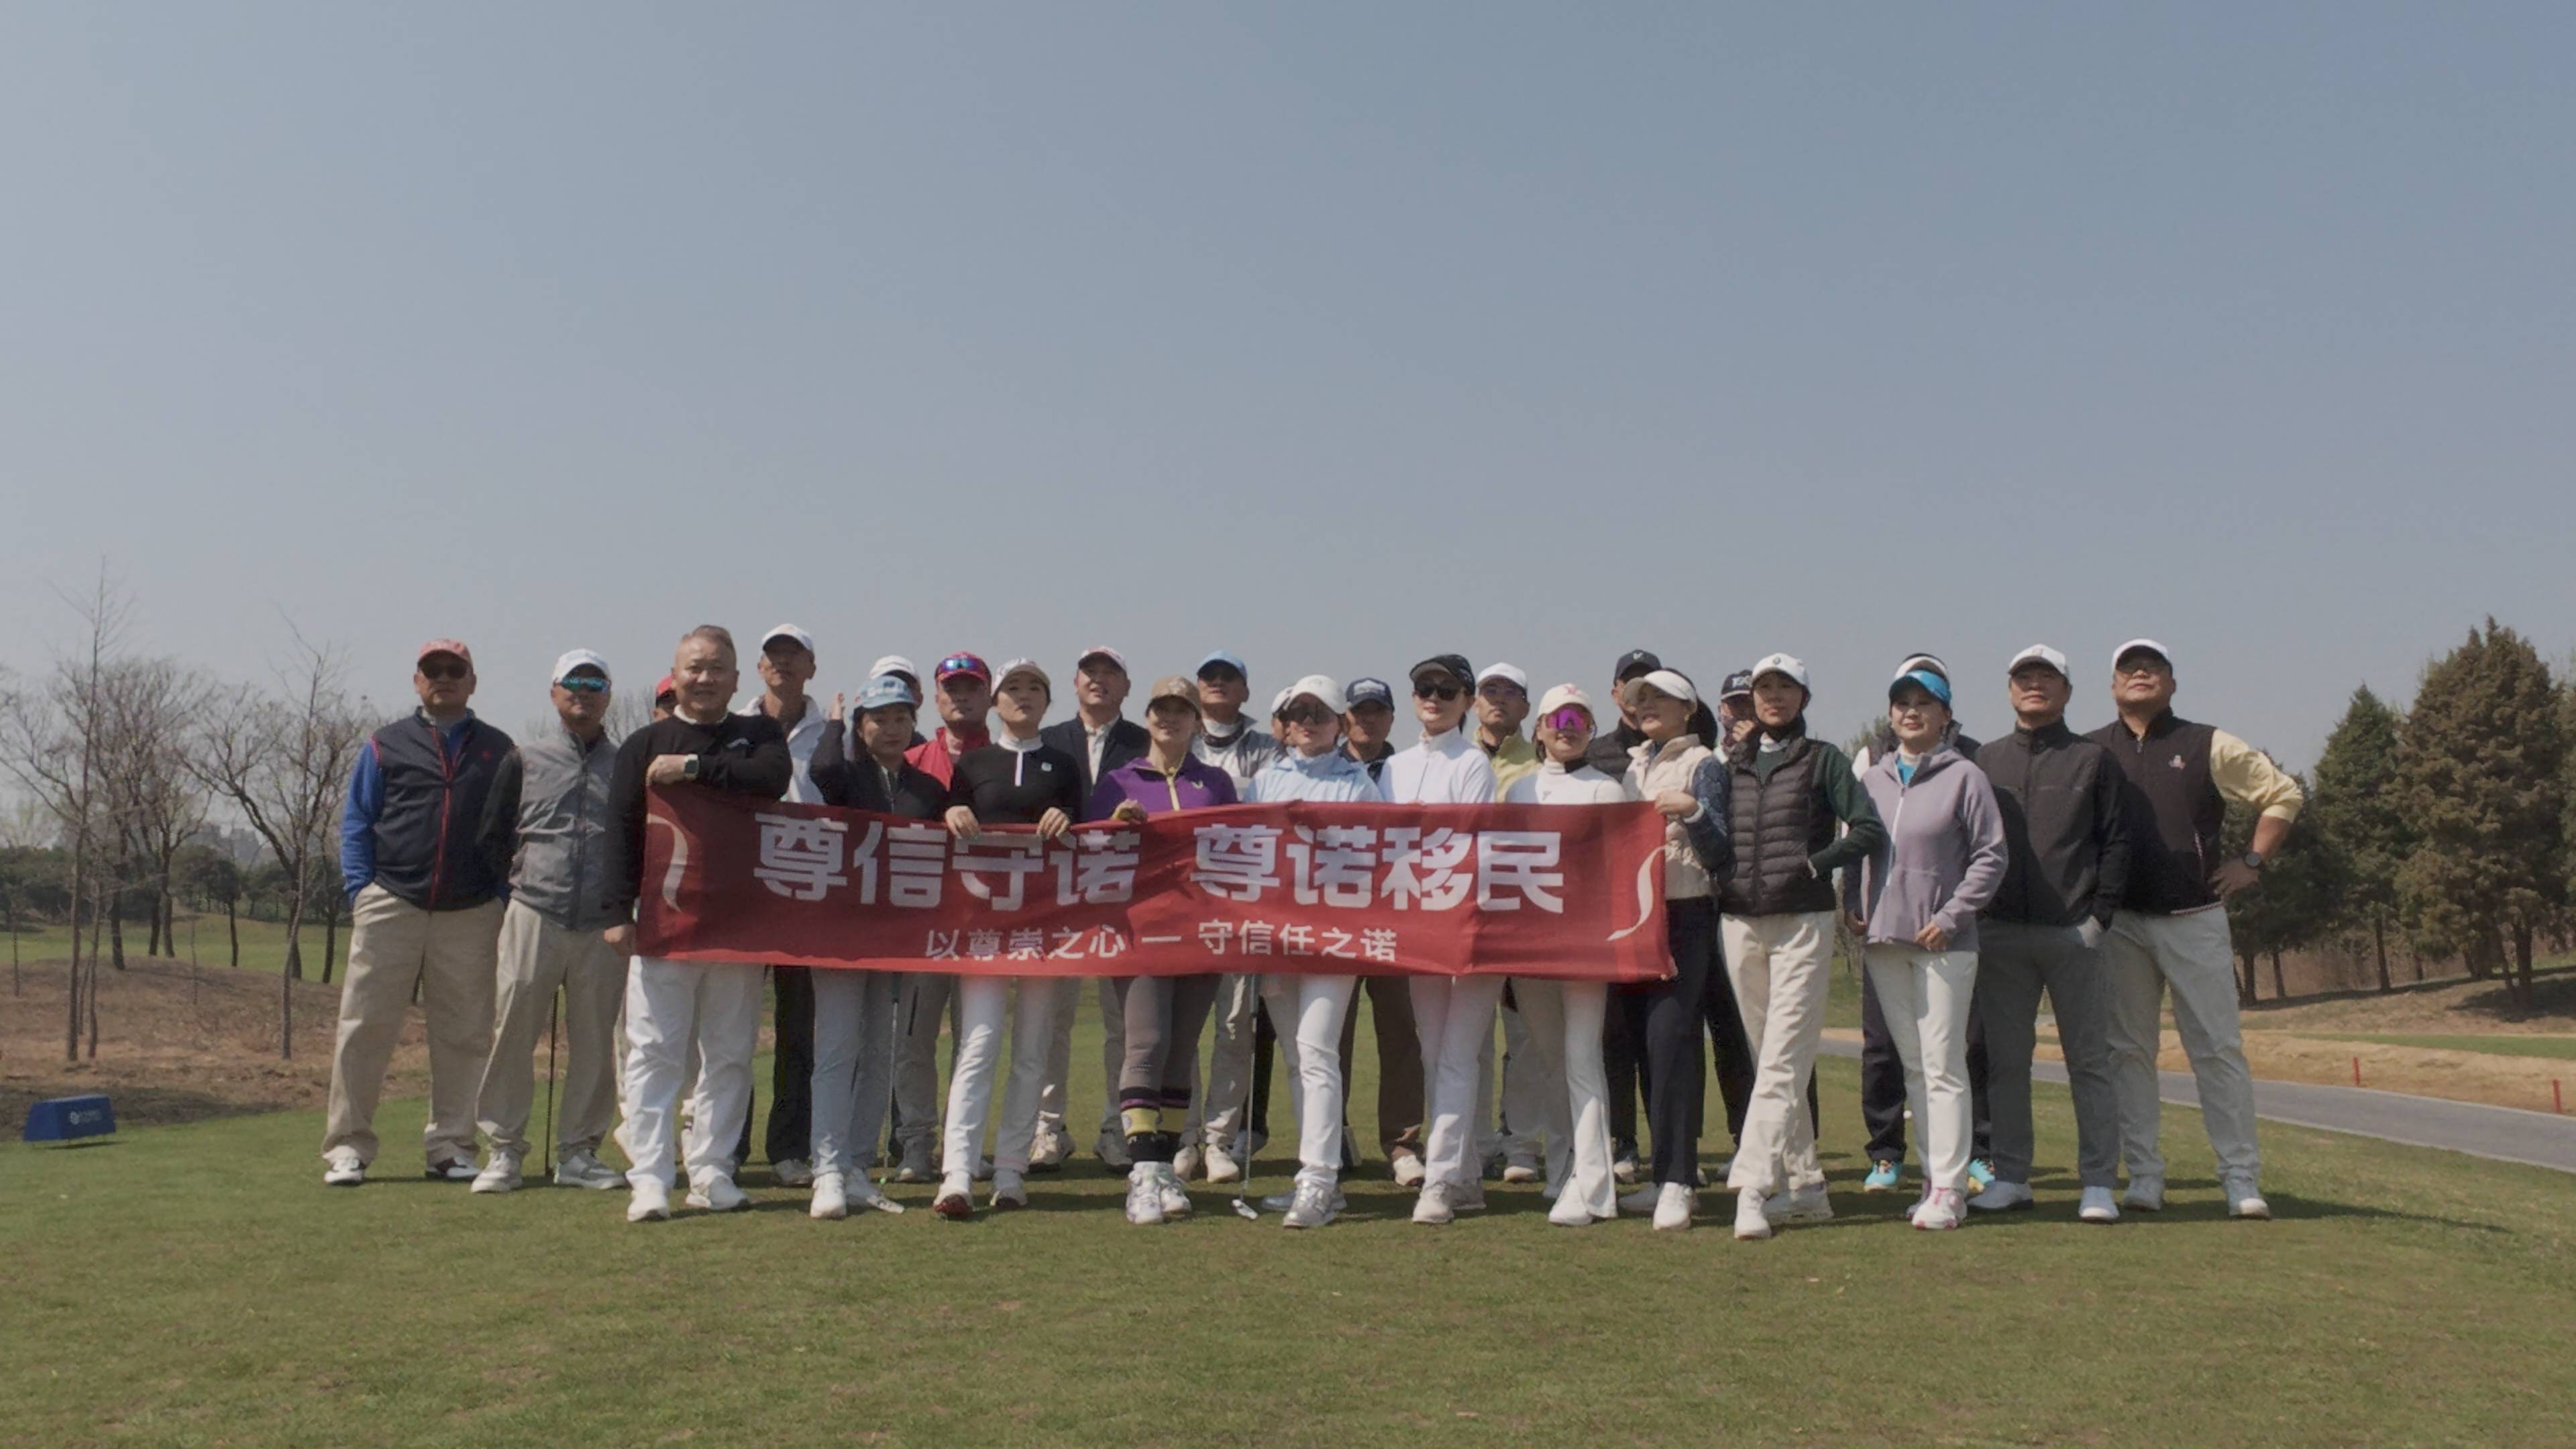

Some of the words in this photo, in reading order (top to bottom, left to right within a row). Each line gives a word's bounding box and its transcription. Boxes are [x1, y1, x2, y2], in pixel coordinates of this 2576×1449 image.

[754, 812, 1140, 911] 尊信守诺
[1190, 823, 1564, 914] 尊诺移民
[925, 924, 1126, 961] 以尊崇之心
[1198, 918, 1397, 963] 守信任之诺
